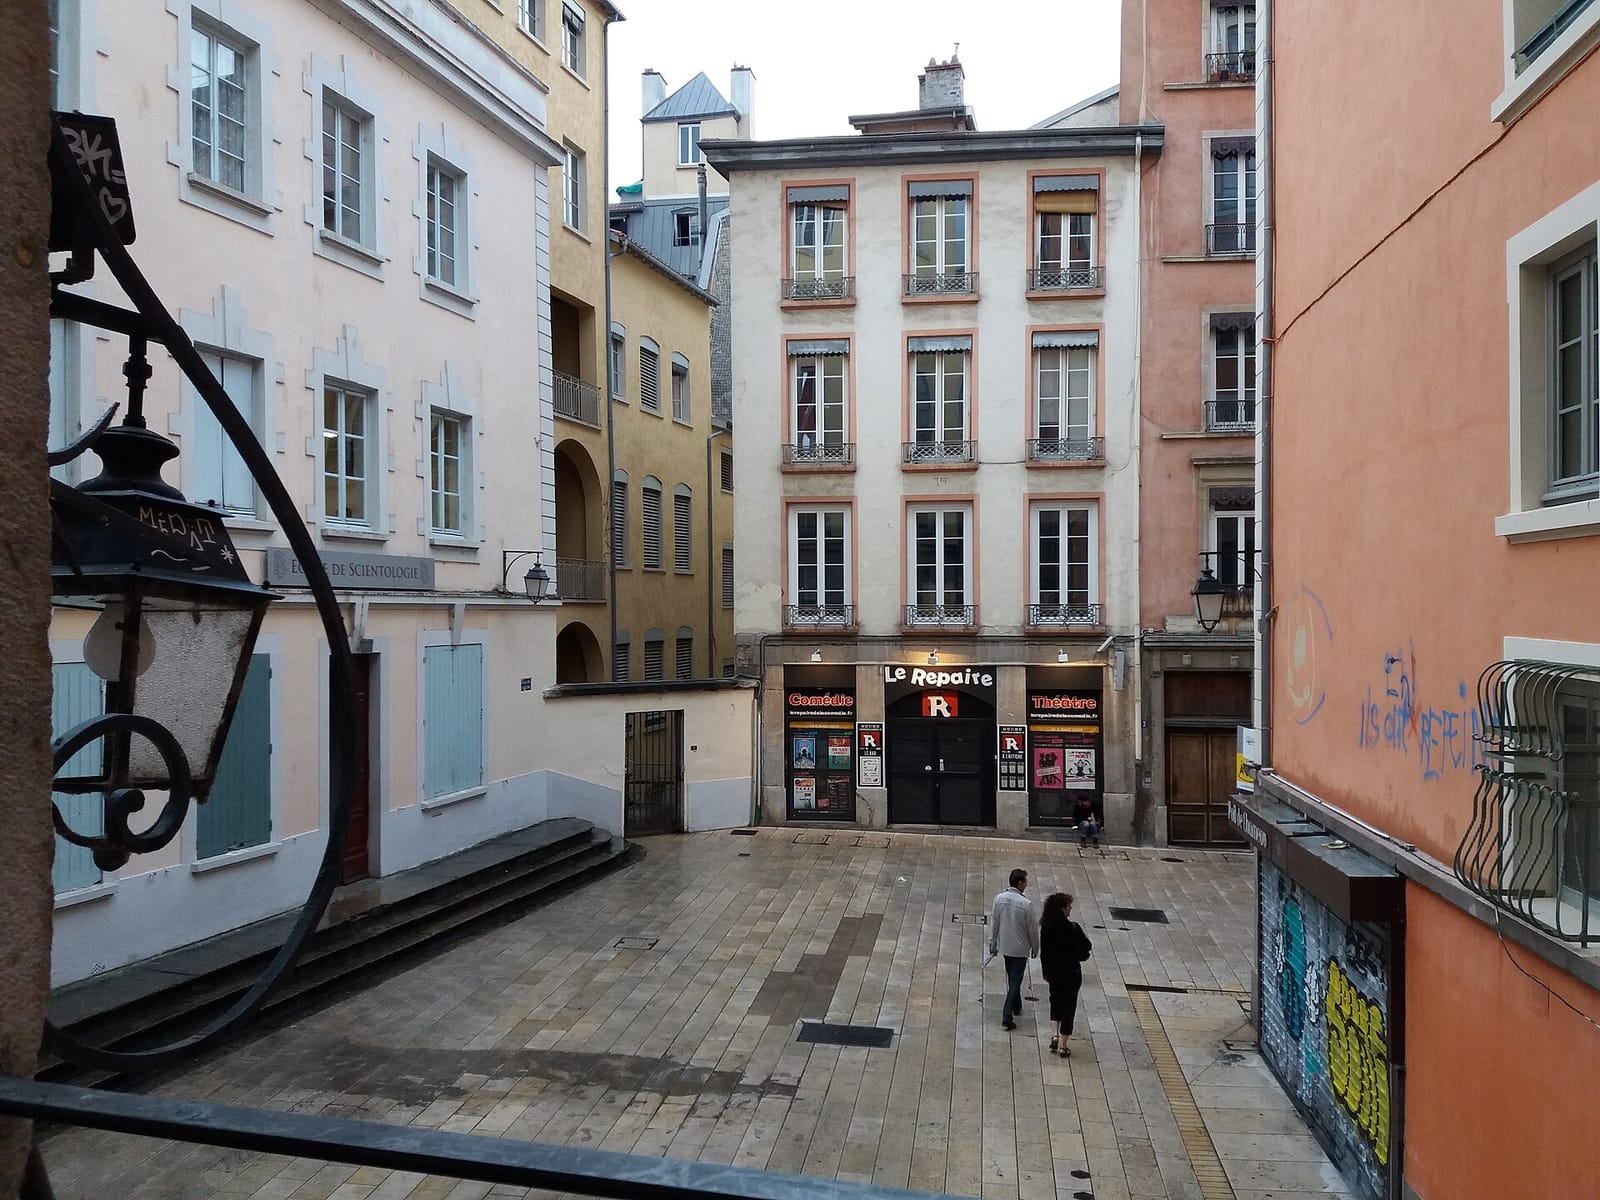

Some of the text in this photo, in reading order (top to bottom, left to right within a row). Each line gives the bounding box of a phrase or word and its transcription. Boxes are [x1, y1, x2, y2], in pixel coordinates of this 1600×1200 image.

[332, 563, 346, 576] DE
[884, 666, 993, 687] Le Repaire
[789, 693, 853, 706] Comédie
[1032, 695, 1097, 709] Théâtre
[928, 696, 951, 718] R
[863, 734, 876, 747] R
[1004, 737, 1019, 751] R
